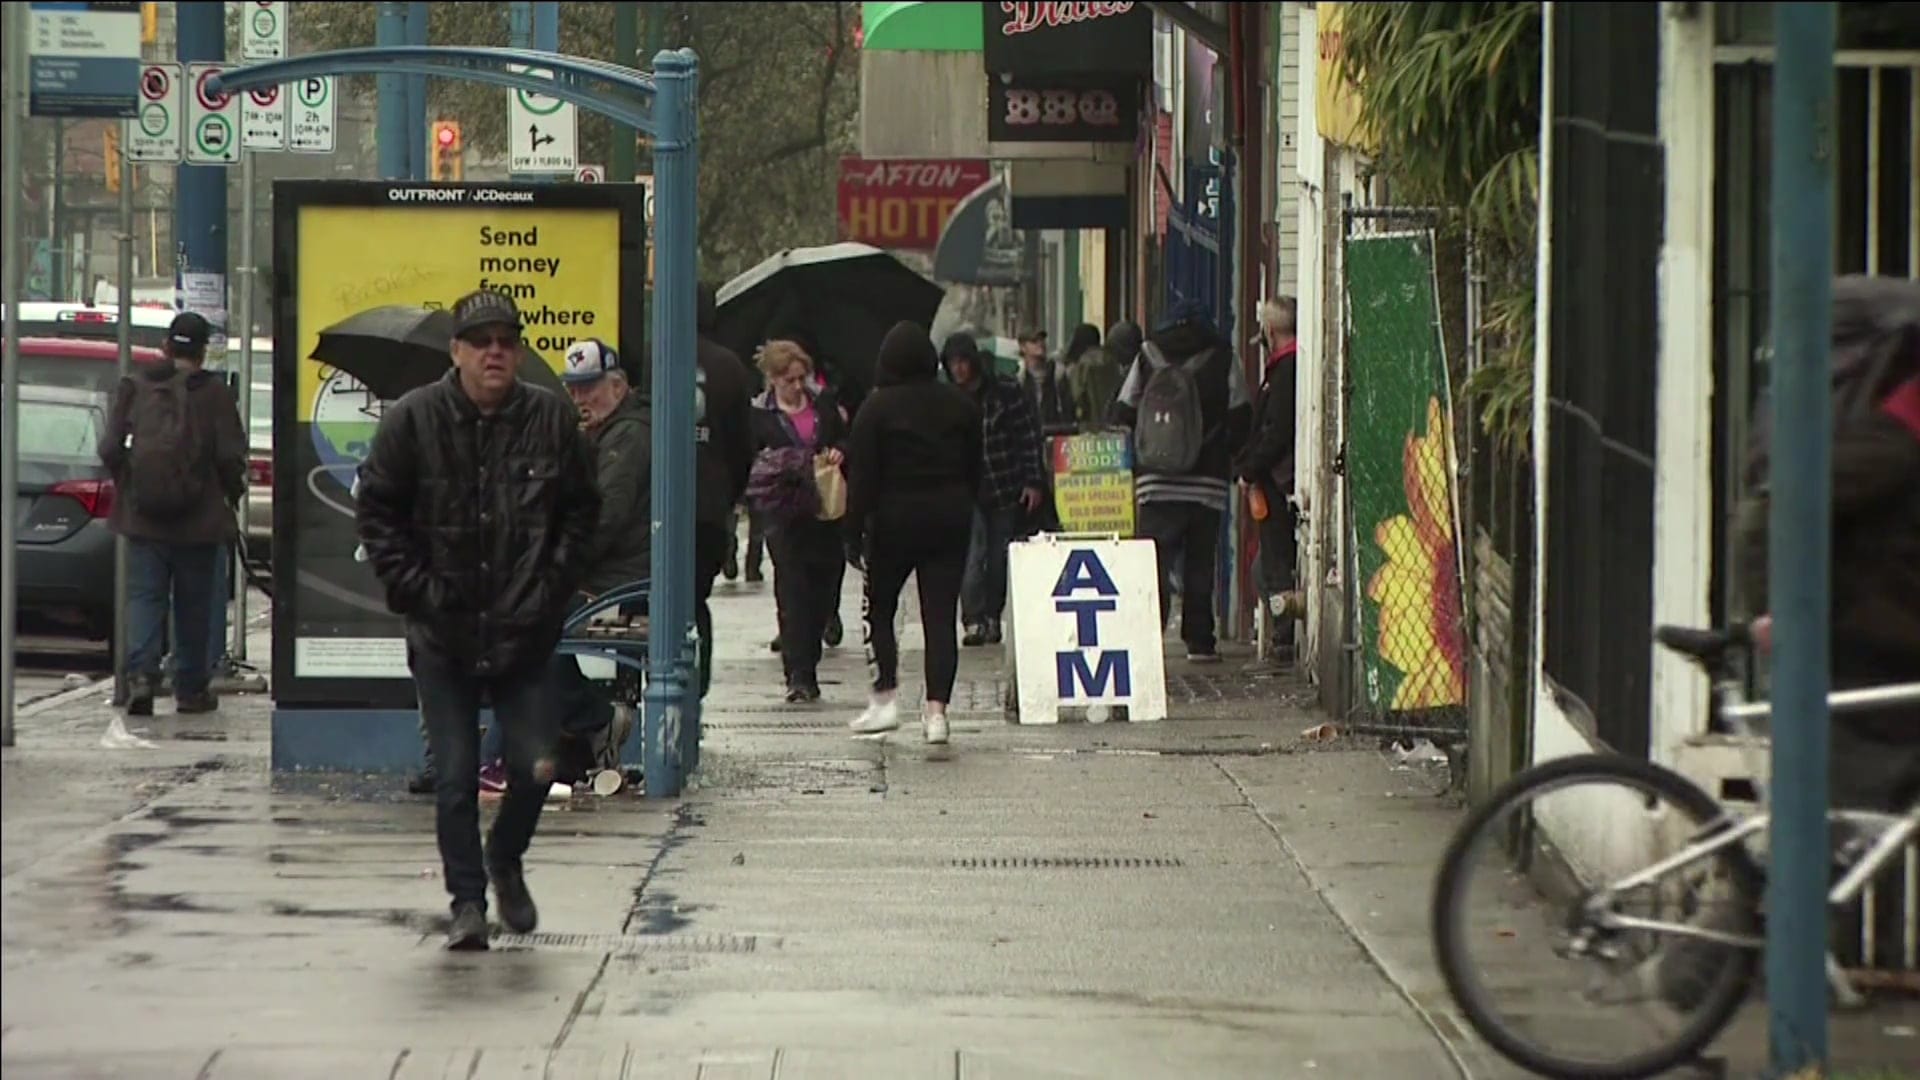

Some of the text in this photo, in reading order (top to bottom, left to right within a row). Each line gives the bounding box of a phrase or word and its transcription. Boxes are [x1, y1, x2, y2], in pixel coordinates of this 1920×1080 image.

[305, 111, 320, 123] 2h
[1004, 89, 1119, 125] BBQ
[865, 164, 962, 187] AFTON
[388, 188, 466, 201] OUTFRONT
[472, 188, 534, 202] JCDecaux
[850, 195, 962, 239] HOTE
[479, 226, 538, 247] Send
[479, 256, 560, 278] money
[536, 336, 577, 351] our
[1051, 549, 1131, 698] ATM
